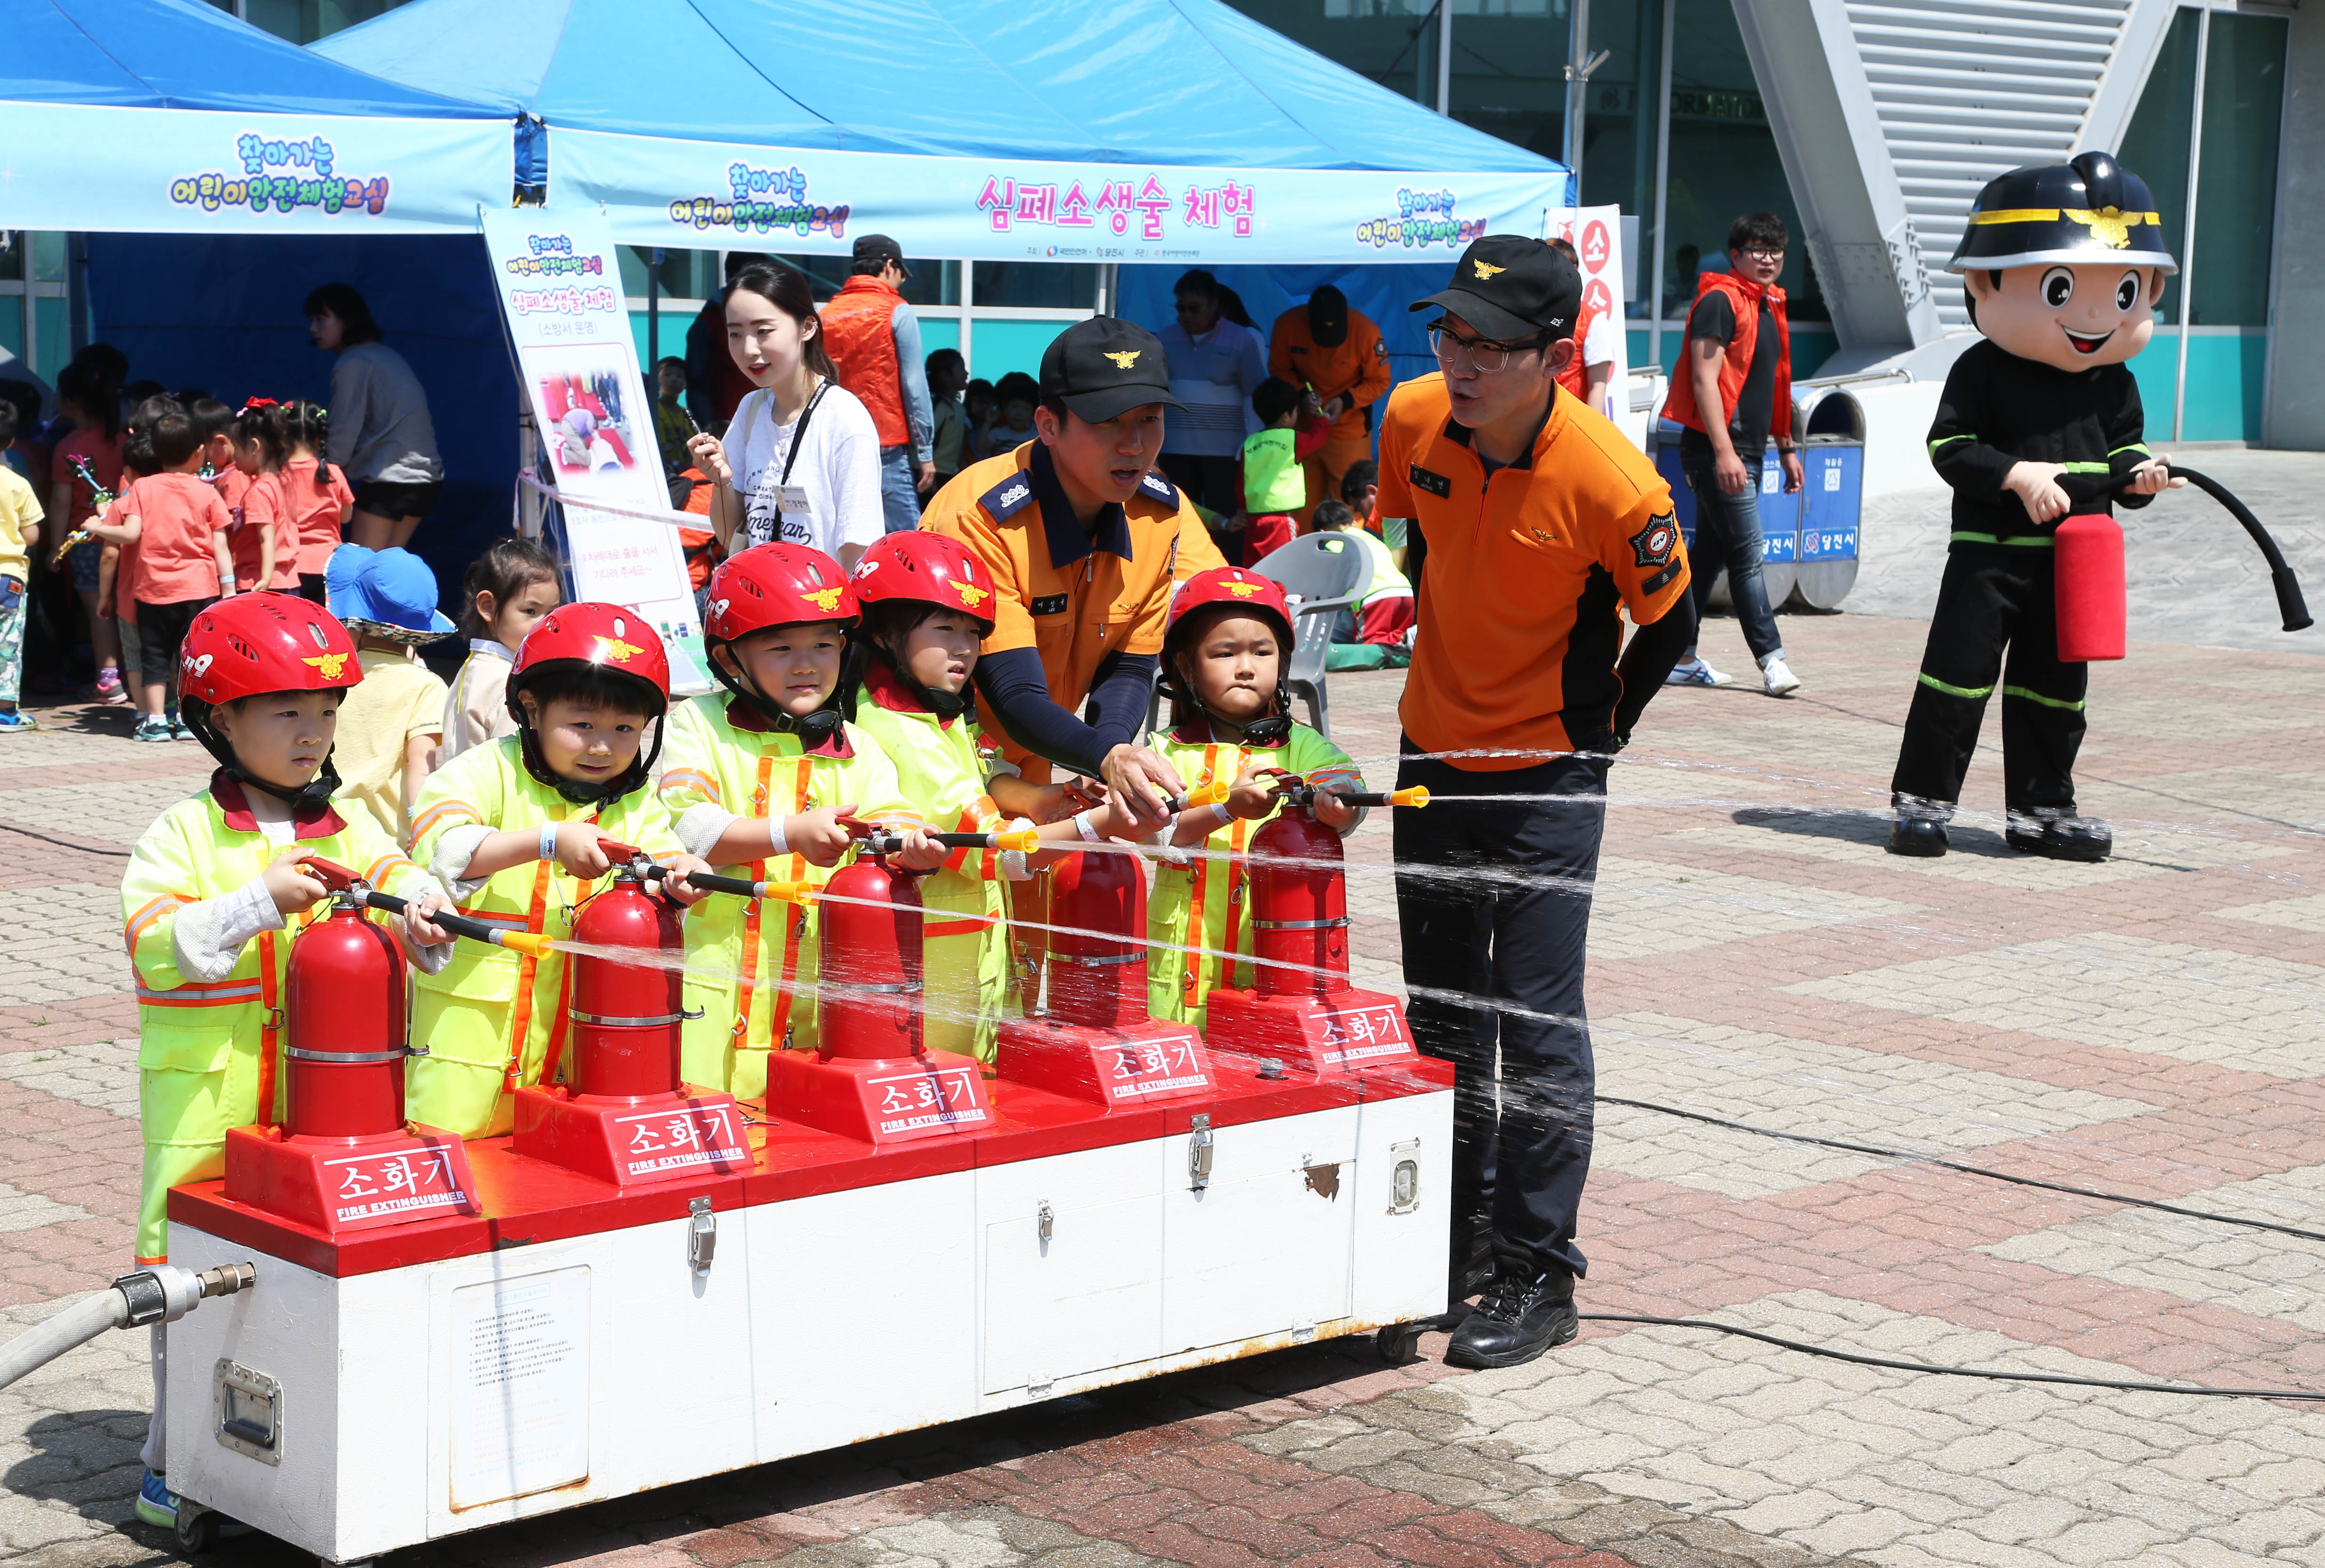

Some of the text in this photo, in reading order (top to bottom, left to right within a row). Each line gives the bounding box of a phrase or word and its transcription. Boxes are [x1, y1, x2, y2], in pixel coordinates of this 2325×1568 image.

[238, 134, 334, 176] 찾아가는
[171, 173, 388, 215] 어린이안전체험교실
[729, 163, 807, 203] 찾아가는
[670, 197, 849, 238] 어린이안전체험교실
[977, 173, 1255, 240] 심폐소생술 체험
[1397, 188, 1455, 218] 찾아가는
[528, 234, 572, 255] 찾아가는
[507, 255, 602, 276] 어린이안전체험교실
[512, 289, 613, 312] 심폐소생술 체험
[539, 321, 597, 336] (소방서 운영)
[1652, 533, 1665, 549] 119
[1763, 537, 1793, 555] 당진시
[1822, 533, 1854, 551] 당진시
[1321, 1009, 1402, 1047] 소화기
[1112, 1040, 1199, 1080] 소화기
[1322, 1042, 1410, 1061] FIRE EXTINGUISHER
[881, 1072, 976, 1115] 소화기
[1112, 1074, 1207, 1095] FIRE EXTINGUISHER
[629, 1109, 735, 1155] 소화기
[880, 1108, 985, 1131] FIRE EXTINGUISHER
[628, 1147, 744, 1172] FIRE EXTINGUISHER
[339, 1150, 455, 1200] 소화기
[336, 1190, 466, 1219] FIRE EXTINGUISHER
